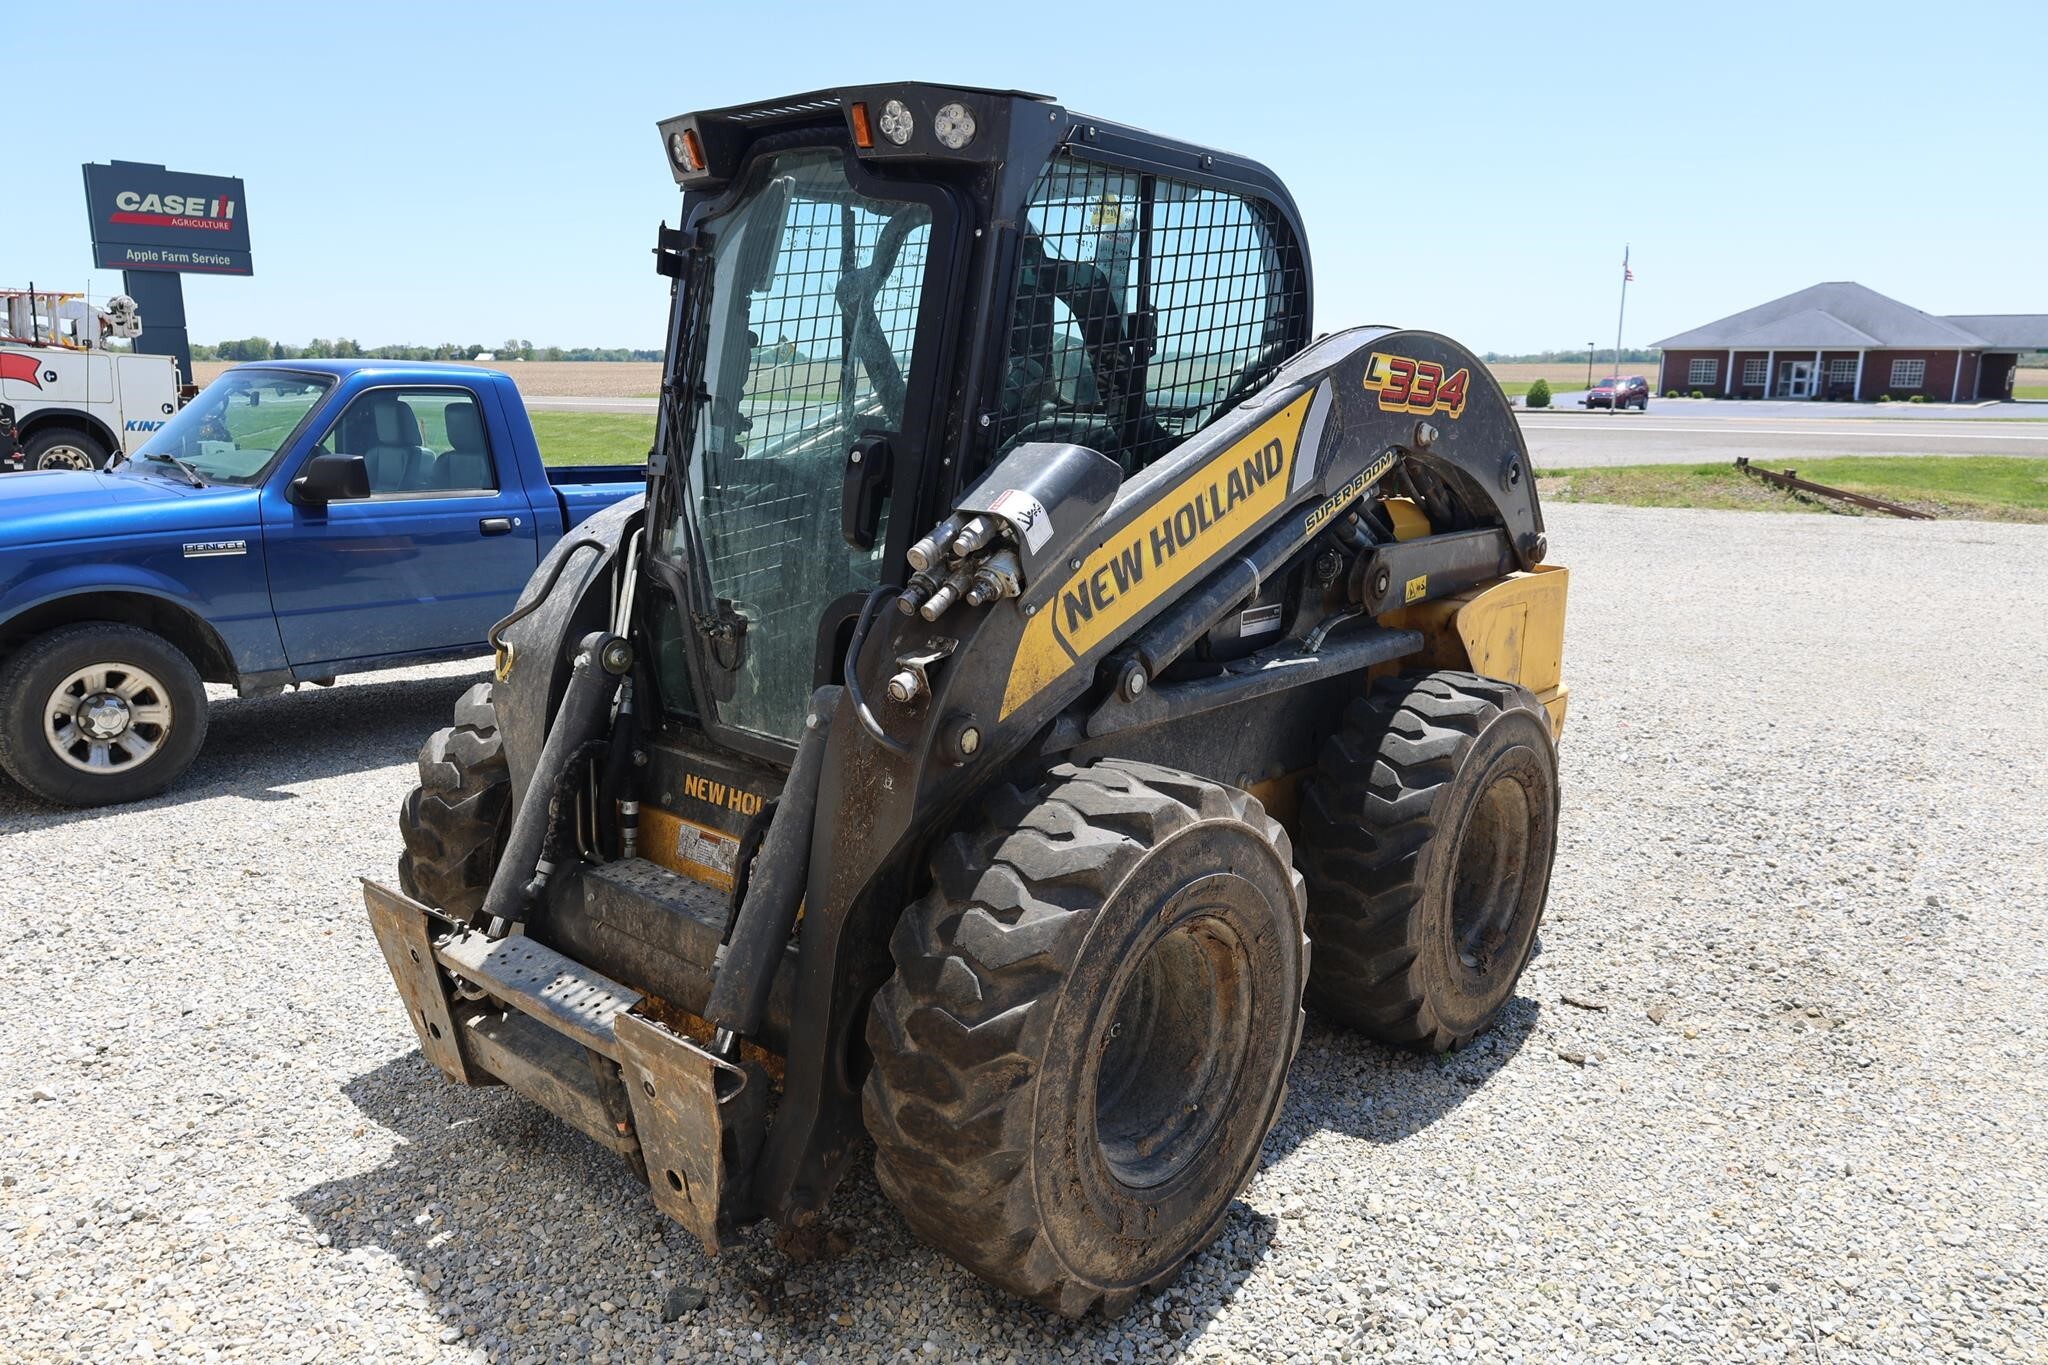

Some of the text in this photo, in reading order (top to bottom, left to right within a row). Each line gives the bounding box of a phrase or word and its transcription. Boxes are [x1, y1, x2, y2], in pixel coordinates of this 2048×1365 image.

[116, 191, 206, 216] CASE
[171, 218, 230, 230] AGRICULTURE
[126, 249, 231, 265] Apple Farm Service
[1363, 352, 1470, 420] L334
[1305, 451, 1392, 533] SUPER BOOM
[184, 541, 246, 552] RANGER
[1062, 437, 1284, 634] NEW HOLLAND
[684, 774, 726, 806] NEW
